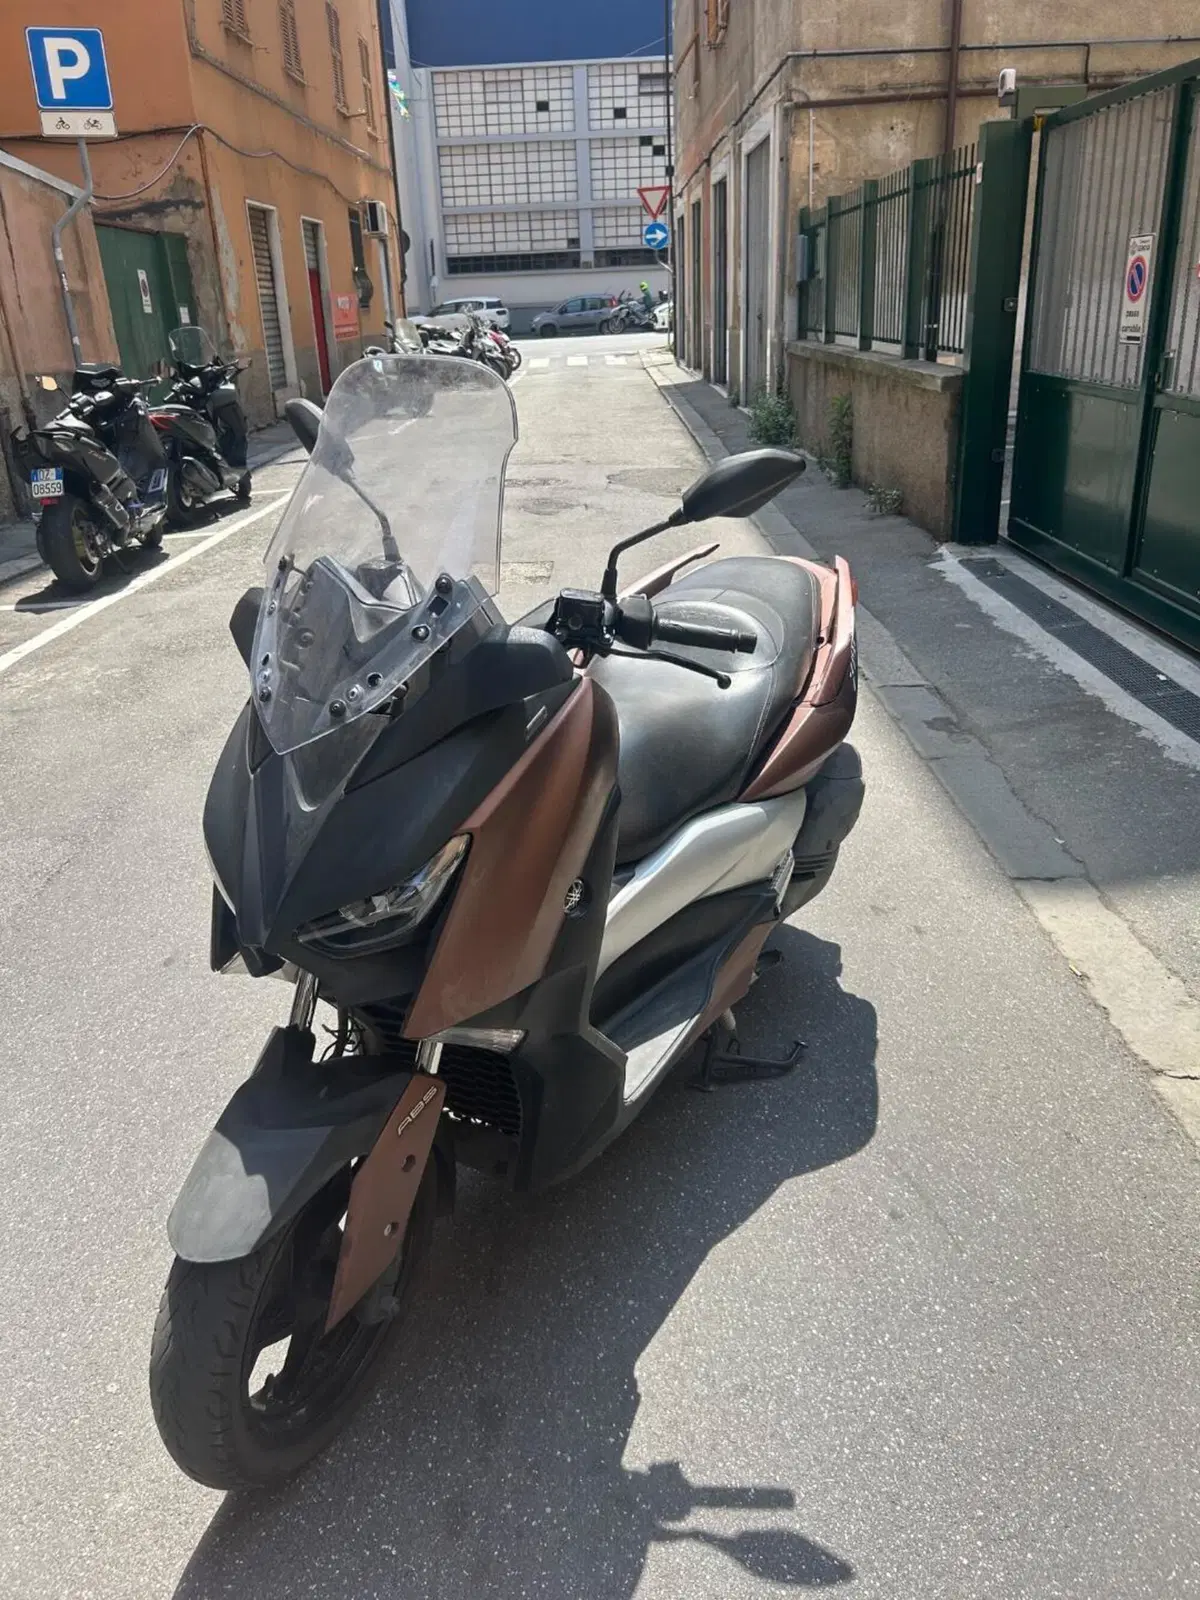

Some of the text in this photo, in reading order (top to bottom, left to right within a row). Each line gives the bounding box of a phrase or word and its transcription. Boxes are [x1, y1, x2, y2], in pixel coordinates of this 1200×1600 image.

[43, 37, 91, 100] P
[33, 481, 62, 495] 08559
[398, 1085, 438, 1136] ABS
